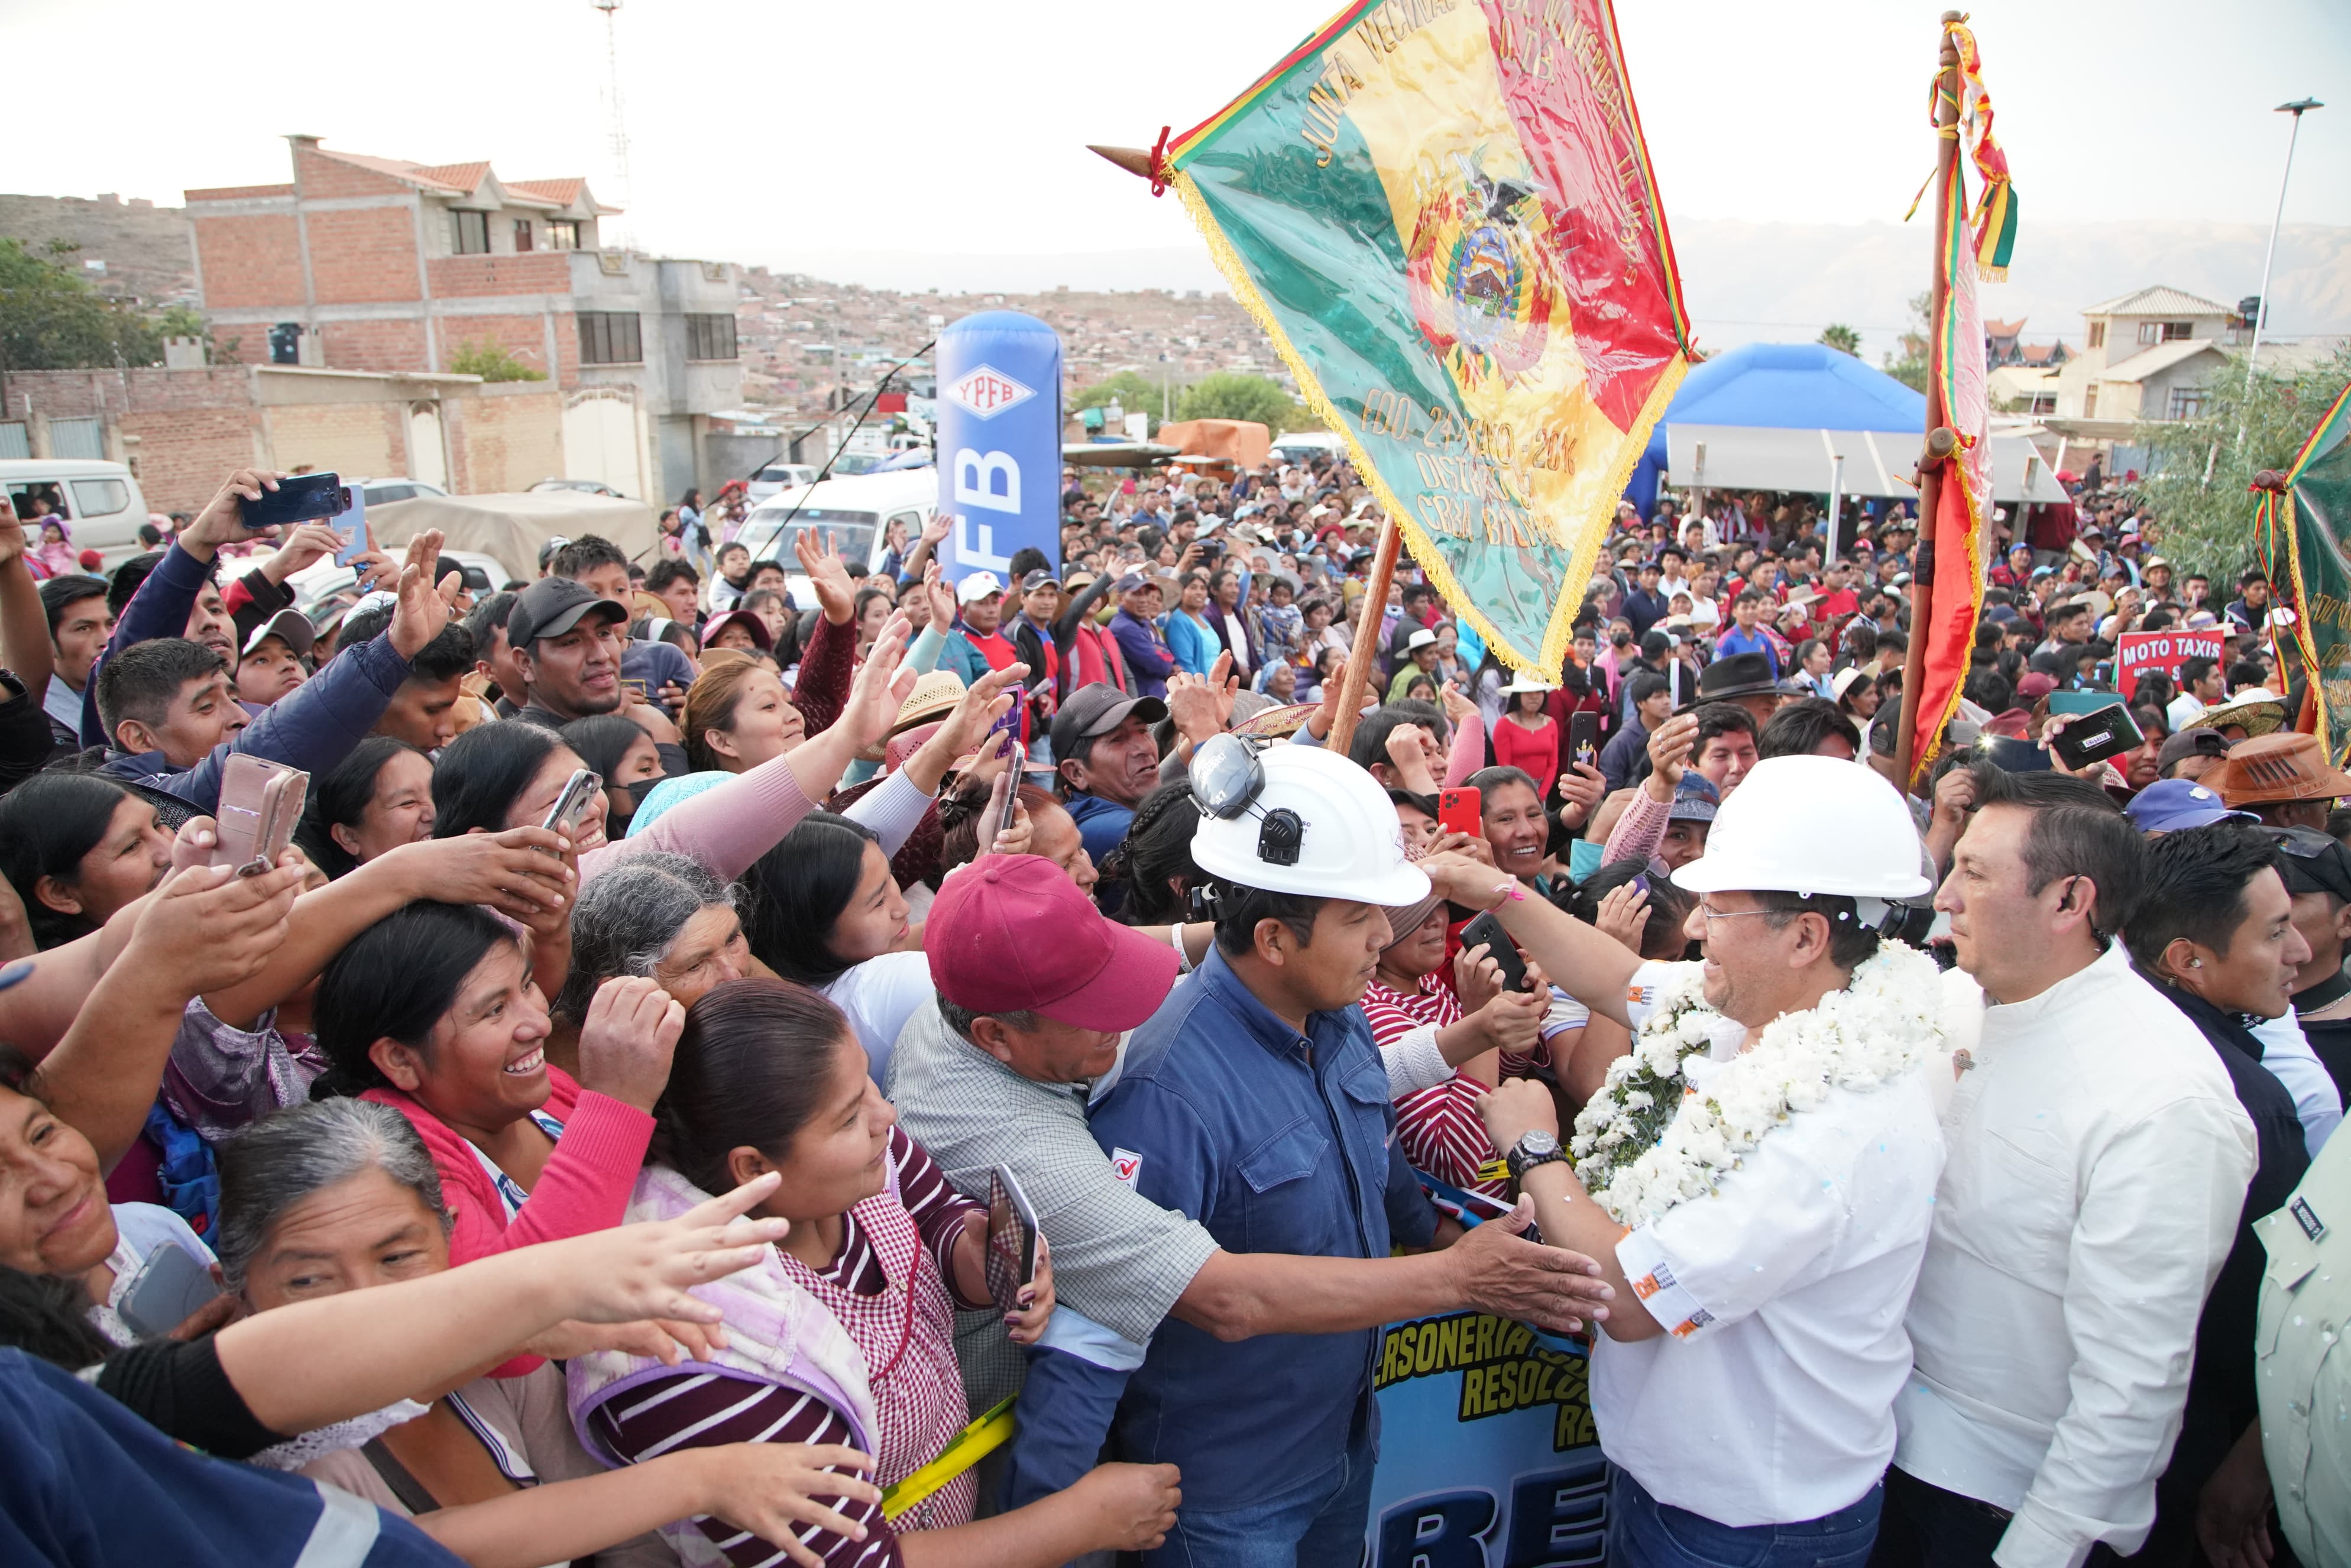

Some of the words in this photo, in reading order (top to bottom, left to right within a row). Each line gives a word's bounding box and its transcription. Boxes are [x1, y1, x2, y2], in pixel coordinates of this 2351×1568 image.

[1301, 51, 1365, 169] JUNTA
[1356, 0, 1457, 64] VECIN
[959, 375, 1014, 409] YPFB
[2123, 639, 2170, 667] MOTO
[2175, 637, 2221, 658] TAXIS
